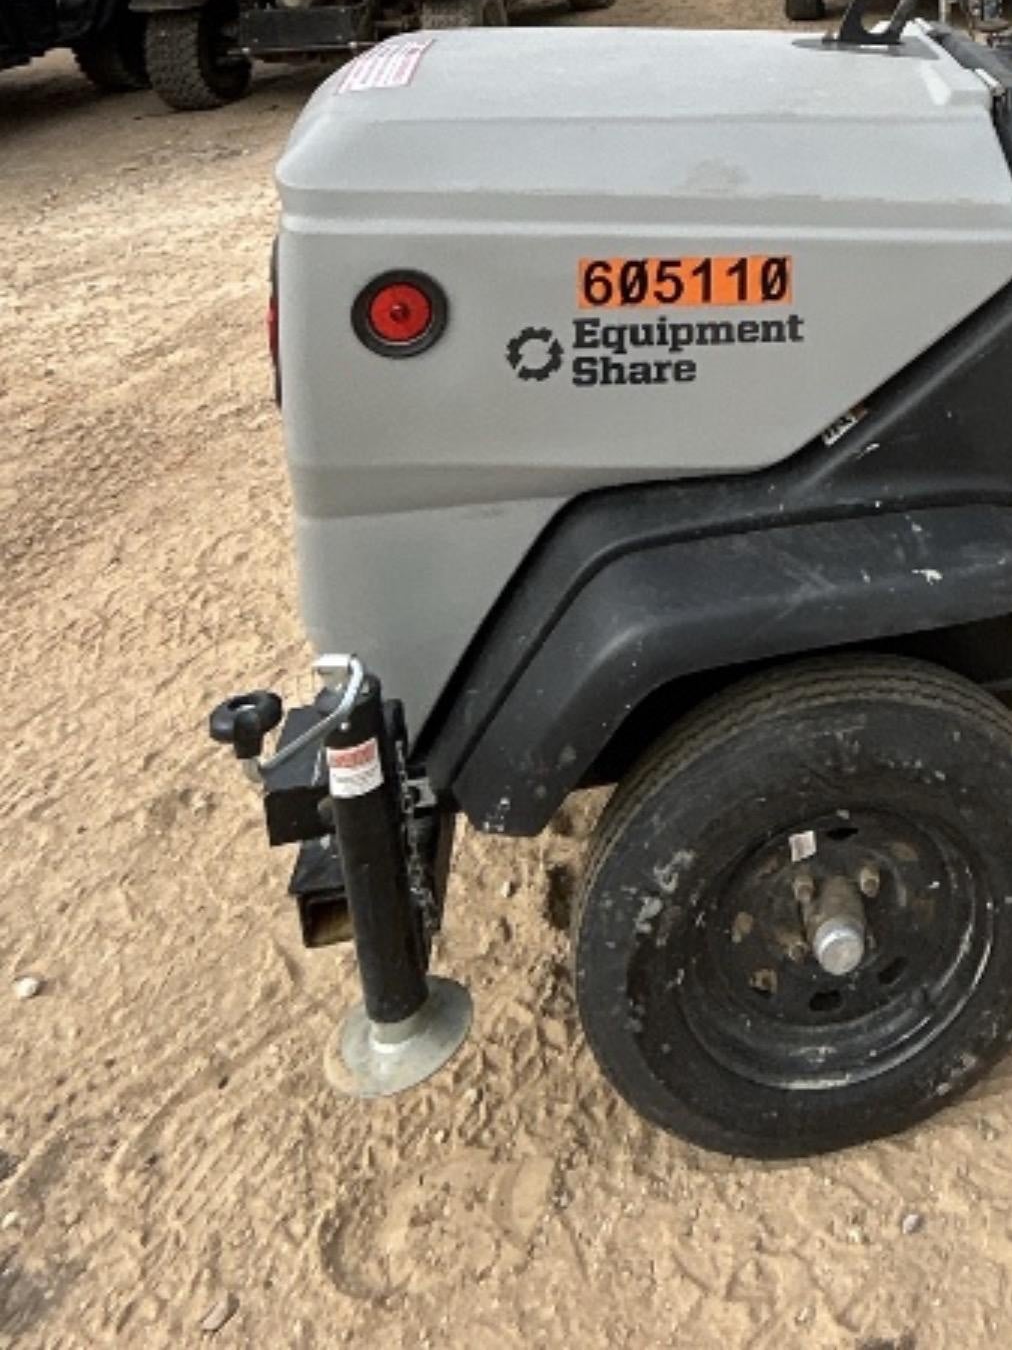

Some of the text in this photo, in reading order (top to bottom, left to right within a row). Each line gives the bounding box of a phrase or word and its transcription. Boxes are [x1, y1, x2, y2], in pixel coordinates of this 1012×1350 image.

[583, 257, 789, 306] 605110
[572, 315, 805, 355] Equipment
[572, 356, 697, 388] Share
